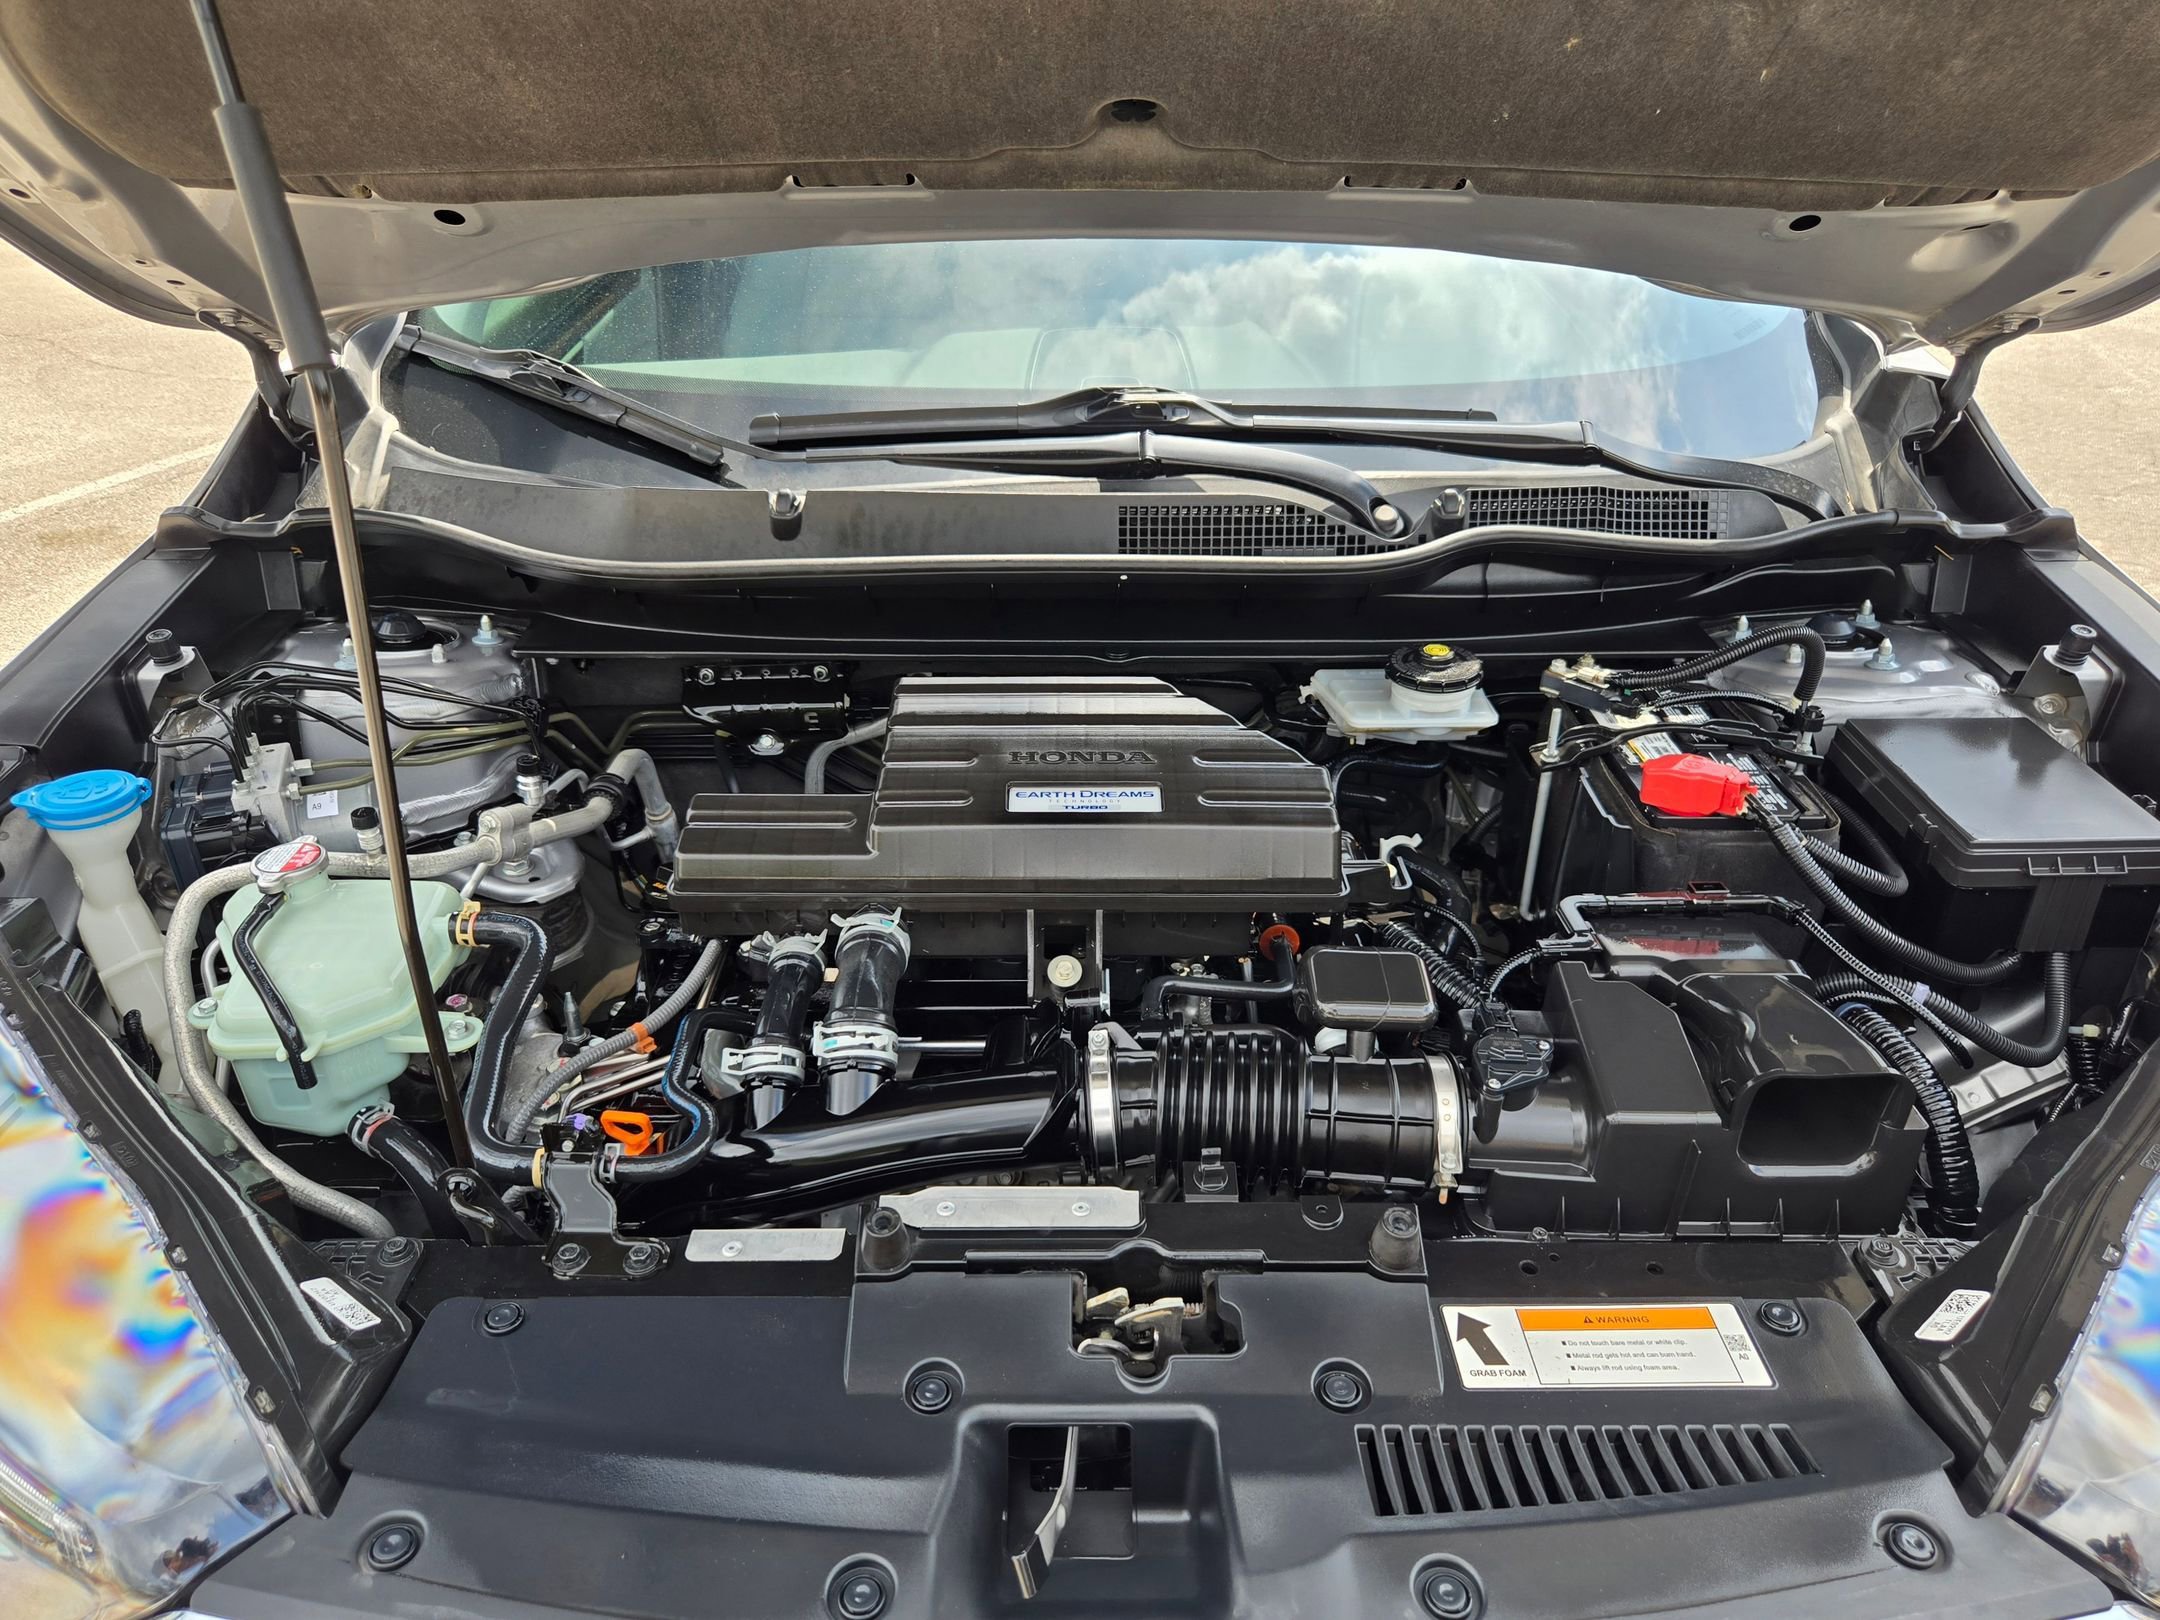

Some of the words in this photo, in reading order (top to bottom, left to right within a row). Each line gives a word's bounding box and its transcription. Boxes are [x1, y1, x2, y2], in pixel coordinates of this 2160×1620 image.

[1008, 750, 1158, 765] HONDA
[1015, 790, 1075, 798] EARTH
[1080, 790, 1154, 798] DREAMS
[1596, 1315, 1650, 1324] WARNING
[1591, 1339, 1610, 1347] touch
[1610, 1339, 1626, 1347] bare
[1605, 1352, 1619, 1360] gets
[1620, 1351, 1631, 1359] hot
[1632, 1351, 1645, 1359] and
[1659, 1350, 1677, 1358] burn
[1677, 1350, 1696, 1358] hand.
[1577, 1364, 1600, 1373] Always
[1601, 1364, 1610, 1372] lift
[1624, 1364, 1643, 1373] using
[1644, 1363, 1661, 1371] foam
[1469, 1369, 1497, 1378] GRAB
[1500, 1369, 1527, 1378] FOAM
